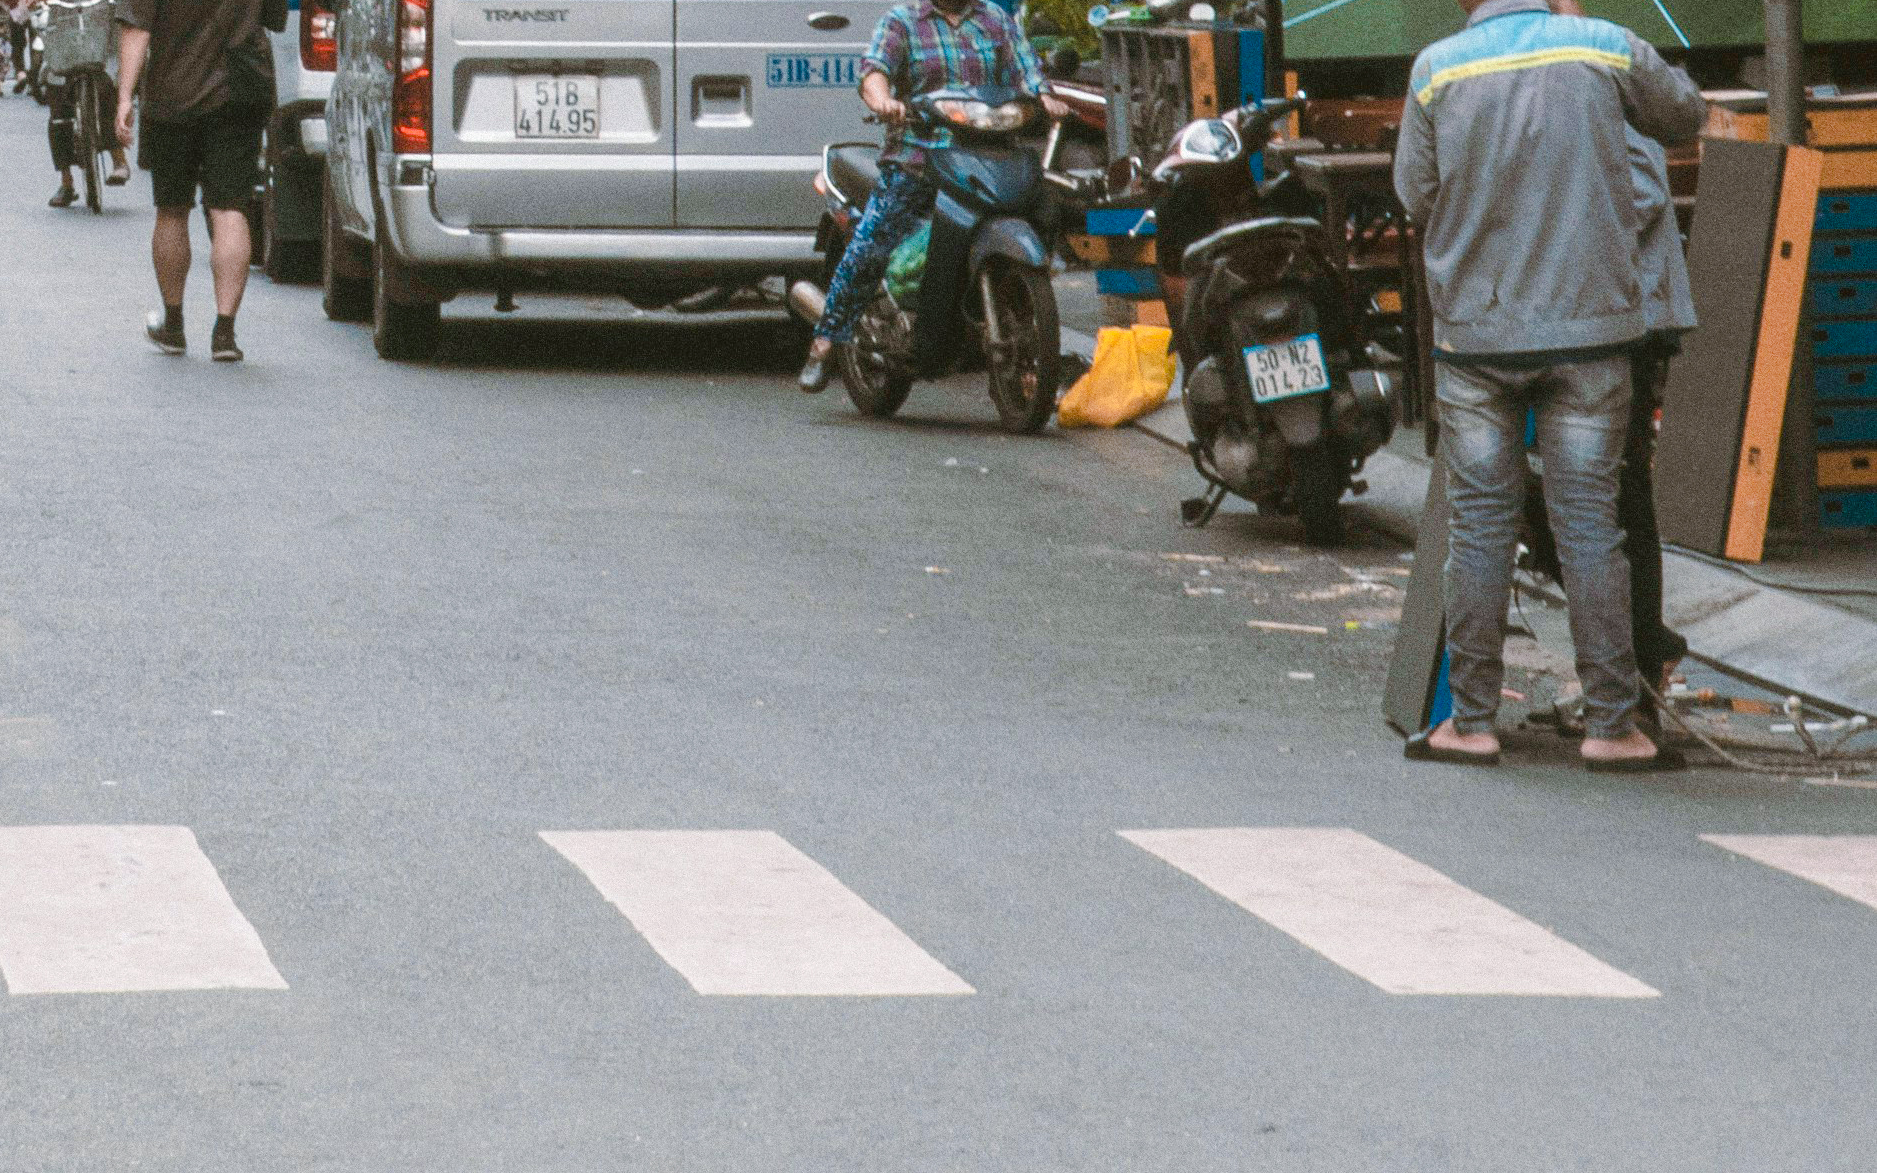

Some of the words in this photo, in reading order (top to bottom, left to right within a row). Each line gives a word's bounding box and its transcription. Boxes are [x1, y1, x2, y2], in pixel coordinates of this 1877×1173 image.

[483, 9, 570, 22] TRANSIT
[770, 57, 857, 84] 51B-414
[537, 81, 579, 106] 51B
[518, 110, 597, 134] 414.95
